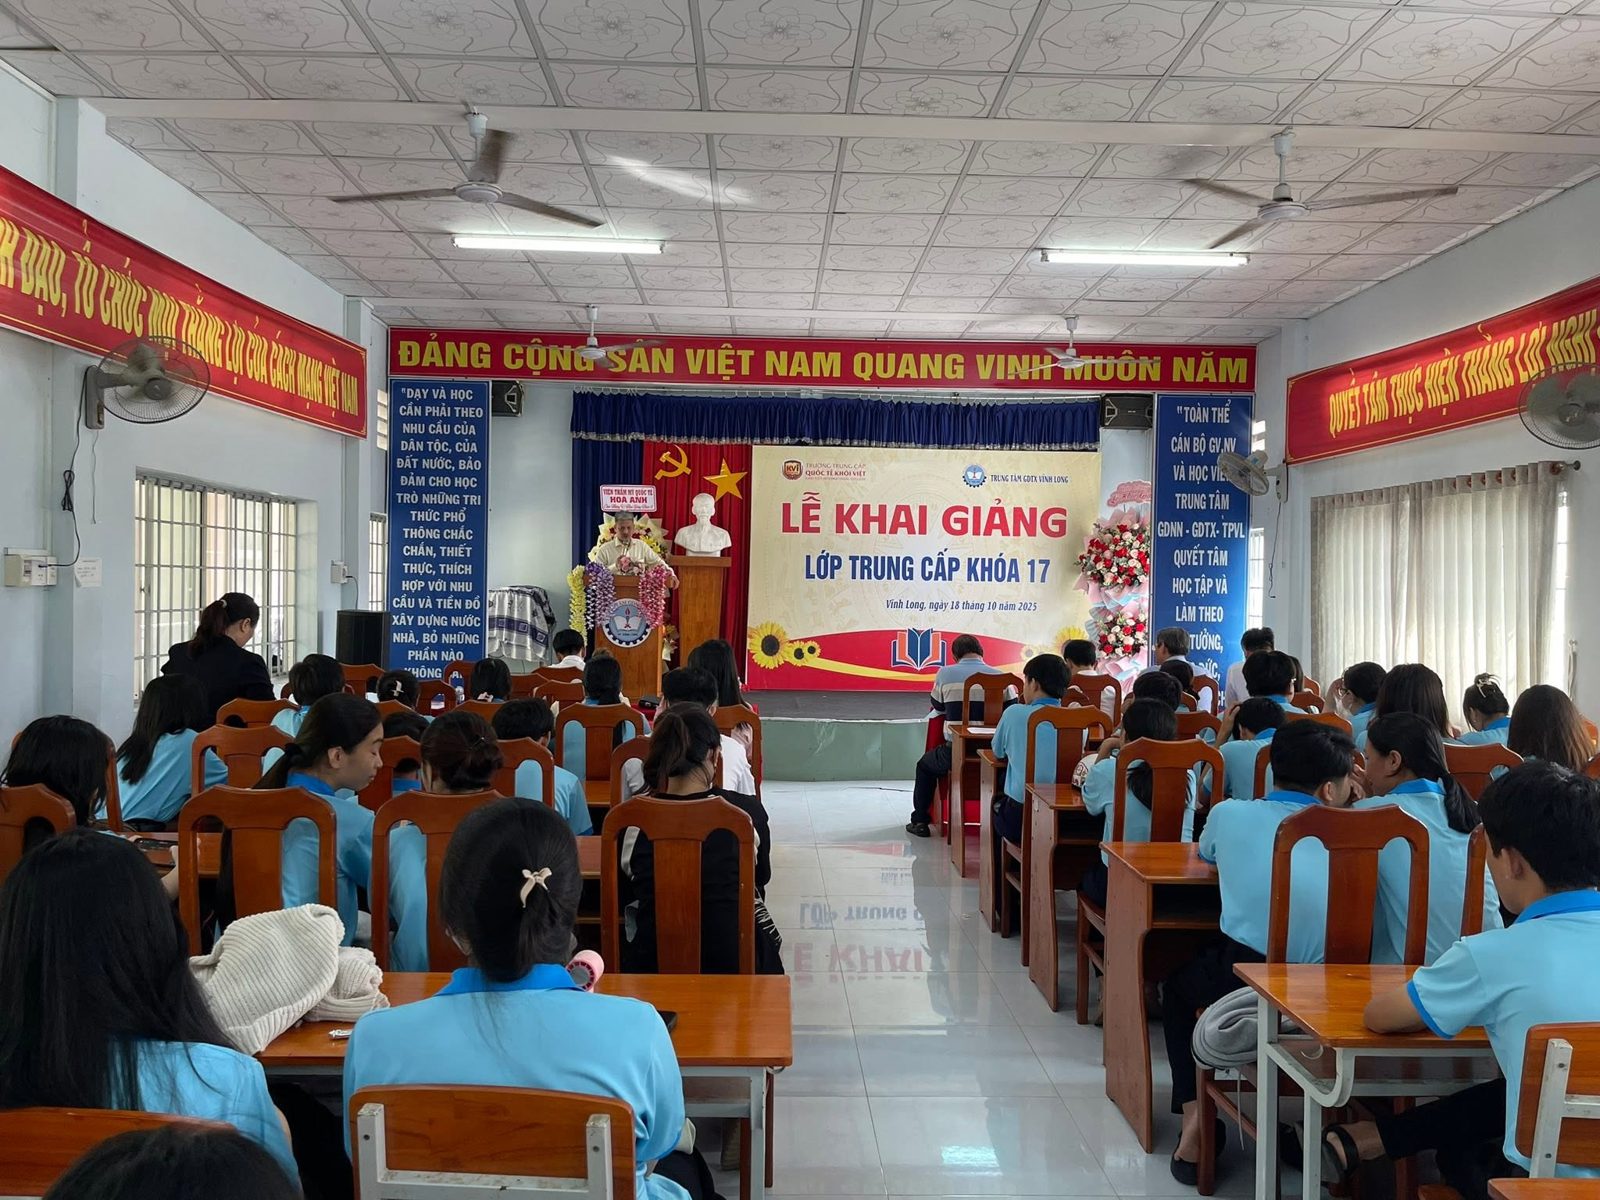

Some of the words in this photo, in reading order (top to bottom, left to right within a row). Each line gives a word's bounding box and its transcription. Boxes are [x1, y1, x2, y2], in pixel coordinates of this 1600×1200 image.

[20, 227, 67, 317] ĐẠO,
[71, 219, 99, 319] TỔ
[100, 257, 148, 338] CHỨC
[147, 286, 179, 360] MỌI
[178, 283, 225, 368] THẮNG
[225, 320, 246, 385] LỢI
[246, 315, 268, 385] CỦA
[270, 330, 296, 395] CÁCH
[297, 352, 322, 410] MẠNG
[324, 357, 341, 418] VIỆT
[341, 371, 358, 416] NAM
[398, 333, 491, 369] ĐẢNG
[503, 338, 595, 376] CỘNG
[685, 342, 755, 381] VIỆT
[765, 351, 841, 378] NAM
[853, 352, 965, 380] QUANG
[976, 354, 1053, 380] VINH
[1064, 350, 1162, 382] MUÔN
[1172, 351, 1248, 383] NĂM
[1329, 367, 1361, 438] QUYẾT
[1362, 370, 1389, 425] TÂM
[1390, 363, 1424, 424] THỰC
[1425, 347, 1460, 415] HIỆN
[1461, 323, 1515, 398] THẮNG
[432, 386, 447, 400] VÀ
[450, 389, 473, 402] HỌC
[399, 402, 422, 416] CẦN
[425, 403, 451, 417] PHẢI
[454, 407, 484, 418] THEO
[1211, 399, 1232, 423] THỂ
[402, 423, 425, 434] NHU
[428, 420, 451, 435] CẦU
[454, 421, 476, 435] CỦA
[401, 439, 424, 452] DÂN
[427, 439, 452, 454] TỘC,
[455, 439, 478, 453] CỦA
[1171, 432, 1190, 453] CÁN
[1193, 433, 1206, 456] BỘ
[396, 454, 419, 469] ĐẤT
[422, 457, 455, 471] NƯỚC,
[458, 456, 481, 470] BẢO
[400, 472, 425, 486] ĐẢM
[428, 477, 451, 487] CHO
[454, 477, 478, 489] HỌC
[1010, 473, 1022, 482] TÂM
[1023, 475, 1038, 483] GDTX
[1173, 461, 1186, 481] VÀ
[1188, 465, 1208, 484] HỌC
[396, 491, 419, 504] TRÒ
[422, 492, 460, 505] NHỮNG
[463, 495, 481, 505] TRI
[1175, 493, 1207, 510] TRUNG
[1209, 489, 1230, 510] TÂM
[410, 508, 440, 522] THỨC
[443, 507, 467, 522] PHỔ
[782, 491, 821, 533] LỄ
[835, 503, 927, 535] KHAI
[942, 498, 1067, 538] GIẢNG
[403, 526, 441, 540] THÔNG
[443, 525, 473, 540] CHẮC
[1157, 521, 1183, 537] GDNN
[1222, 521, 1245, 538] TPVL
[402, 542, 436, 558] CHẮN,
[439, 543, 472, 557] THIẾT
[1173, 543, 1205, 568] QUYẾT
[1207, 546, 1228, 567] TÂM
[403, 562, 436, 576] THỰC,
[439, 563, 472, 575] THÍCH
[805, 549, 842, 579] LỚP
[848, 555, 914, 580] TRUNG
[921, 548, 960, 582] CẤP
[967, 552, 1020, 582] KHÓA
[1027, 559, 1050, 583] 17
[402, 579, 425, 593] HỢP
[428, 579, 446, 592] VỚI
[450, 582, 473, 593] NHU
[1172, 578, 1192, 597] HỌC
[1194, 574, 1213, 597] TẬP
[1216, 574, 1228, 594] VÀ
[392, 594, 415, 609] CẦU
[418, 596, 433, 609] VÀ
[436, 594, 462, 609] TIỀN
[465, 595, 481, 610] ĐỒ
[886, 599, 904, 609] Vĩnh
[905, 600, 927, 612] Long,
[929, 600, 948, 612] ngày
[950, 600, 960, 610] 18
[962, 600, 985, 612] tháng
[987, 601, 997, 610] 10
[998, 601, 1016, 611] năm
[1018, 602, 1037, 611] 2025
[1175, 602, 1196, 622] LÀM
[1198, 605, 1224, 622] THEO
[391, 613, 414, 626] XÂY
[417, 614, 448, 628] DỰNG
[451, 614, 481, 627] NƯỚC
[392, 630, 420, 645] NHÀ,
[422, 630, 438, 643] BỎ
[441, 632, 480, 644] NHỮNG
[1189, 628, 1223, 653] TƯỞNG,
[407, 646, 438, 661] PHẦN
[441, 648, 464, 662] NÀO
